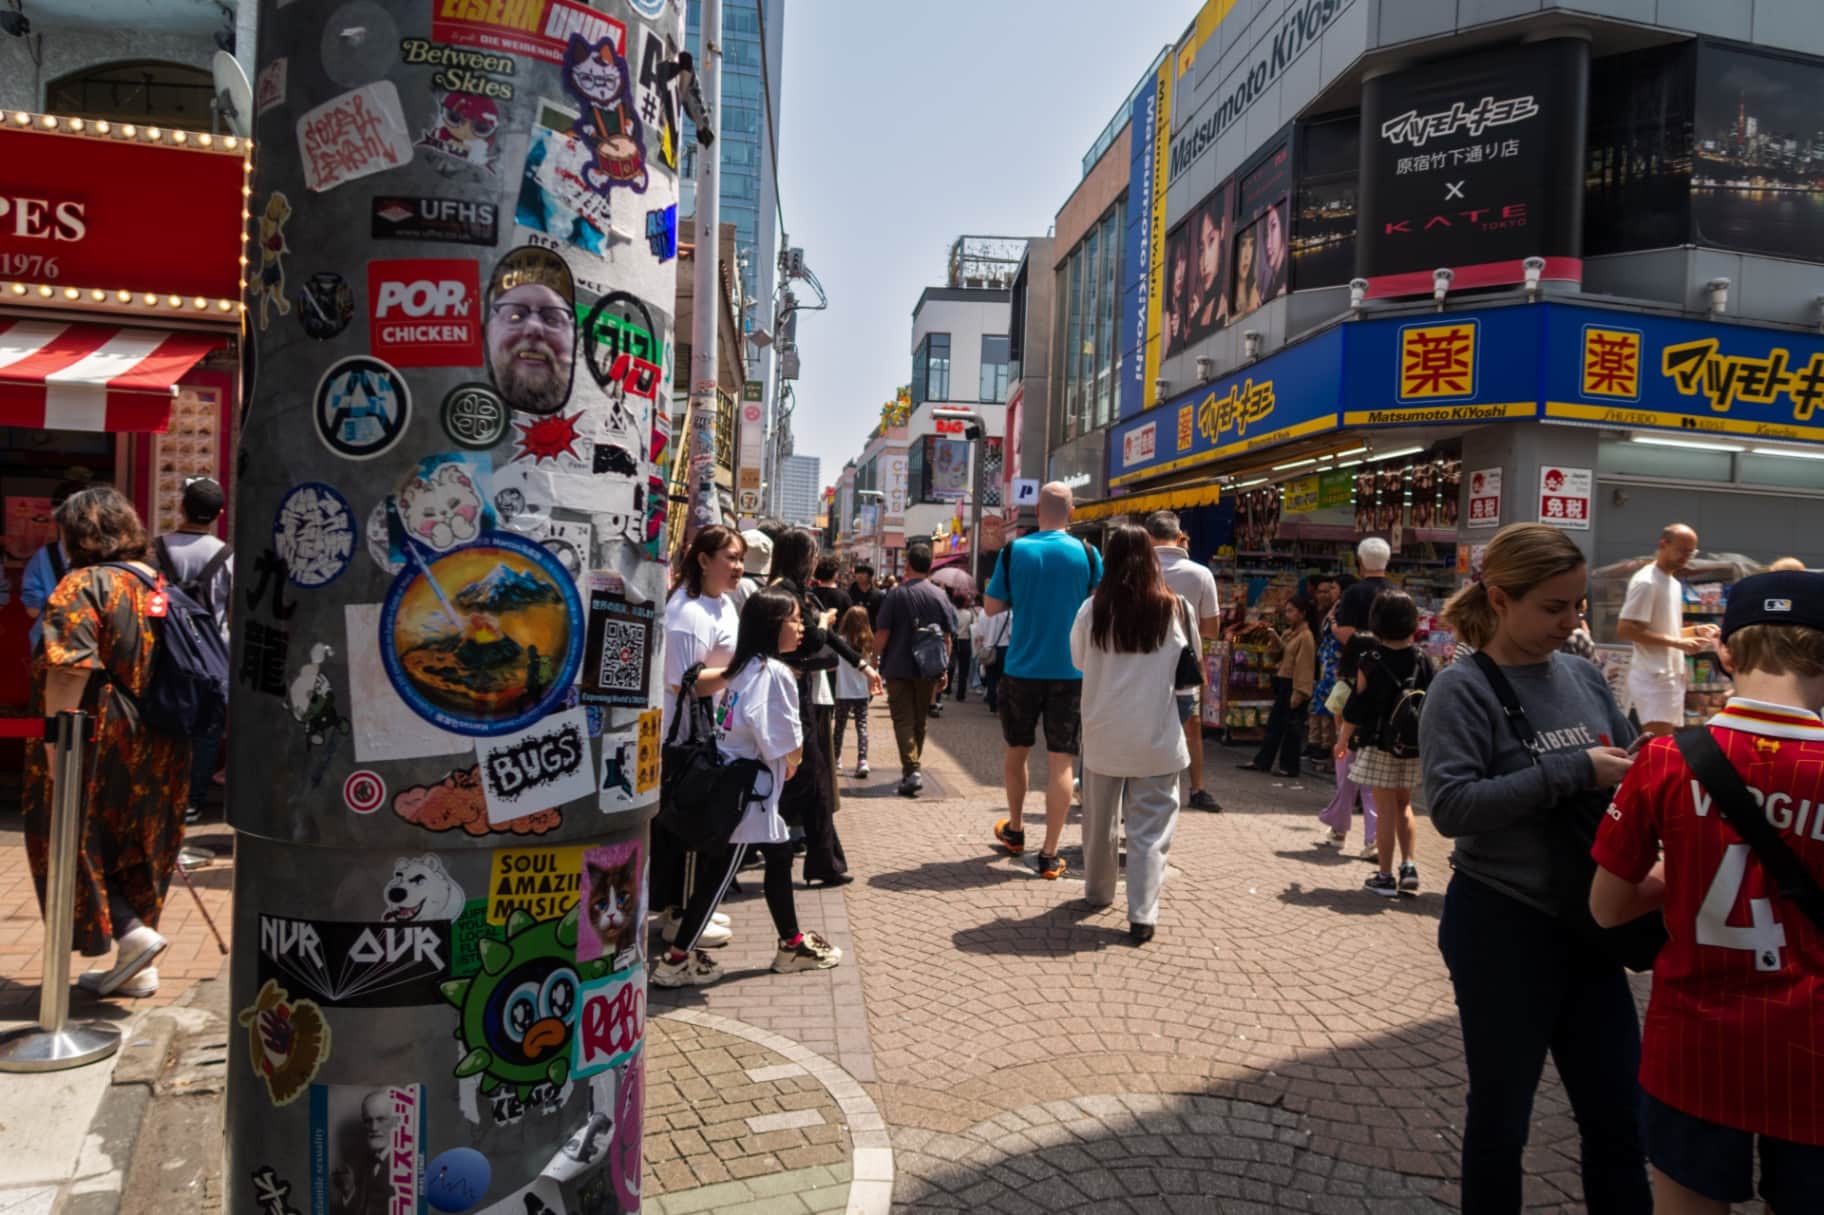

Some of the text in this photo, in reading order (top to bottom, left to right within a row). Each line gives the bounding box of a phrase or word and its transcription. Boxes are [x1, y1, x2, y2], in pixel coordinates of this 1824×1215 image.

[403, 40, 513, 74] Between
[435, 68, 513, 98] Skies
[1169, 59, 1268, 183] Matsumoto
[1381, 95, 1540, 147] マツモトキヨシ
[1396, 139, 1520, 176] 原宿竹下通り店
[421, 199, 494, 225] UFHS
[1481, 217, 1527, 232] TOKYO
[0, 253, 60, 279] 1976
[382, 325, 469, 343] CHICKEN
[1405, 328, 1471, 395] 薬
[1586, 333, 1637, 394] 薬
[1198, 379, 1275, 444] マツモトキヨシ
[1368, 405, 1507, 423] Matsumoto KiYoshi
[1547, 498, 1583, 519] 免税
[492, 735, 577, 792] BUGS
[1690, 779, 1824, 843] VGIL
[501, 853, 557, 874] SOUL
[1695, 843, 1786, 972] 4
